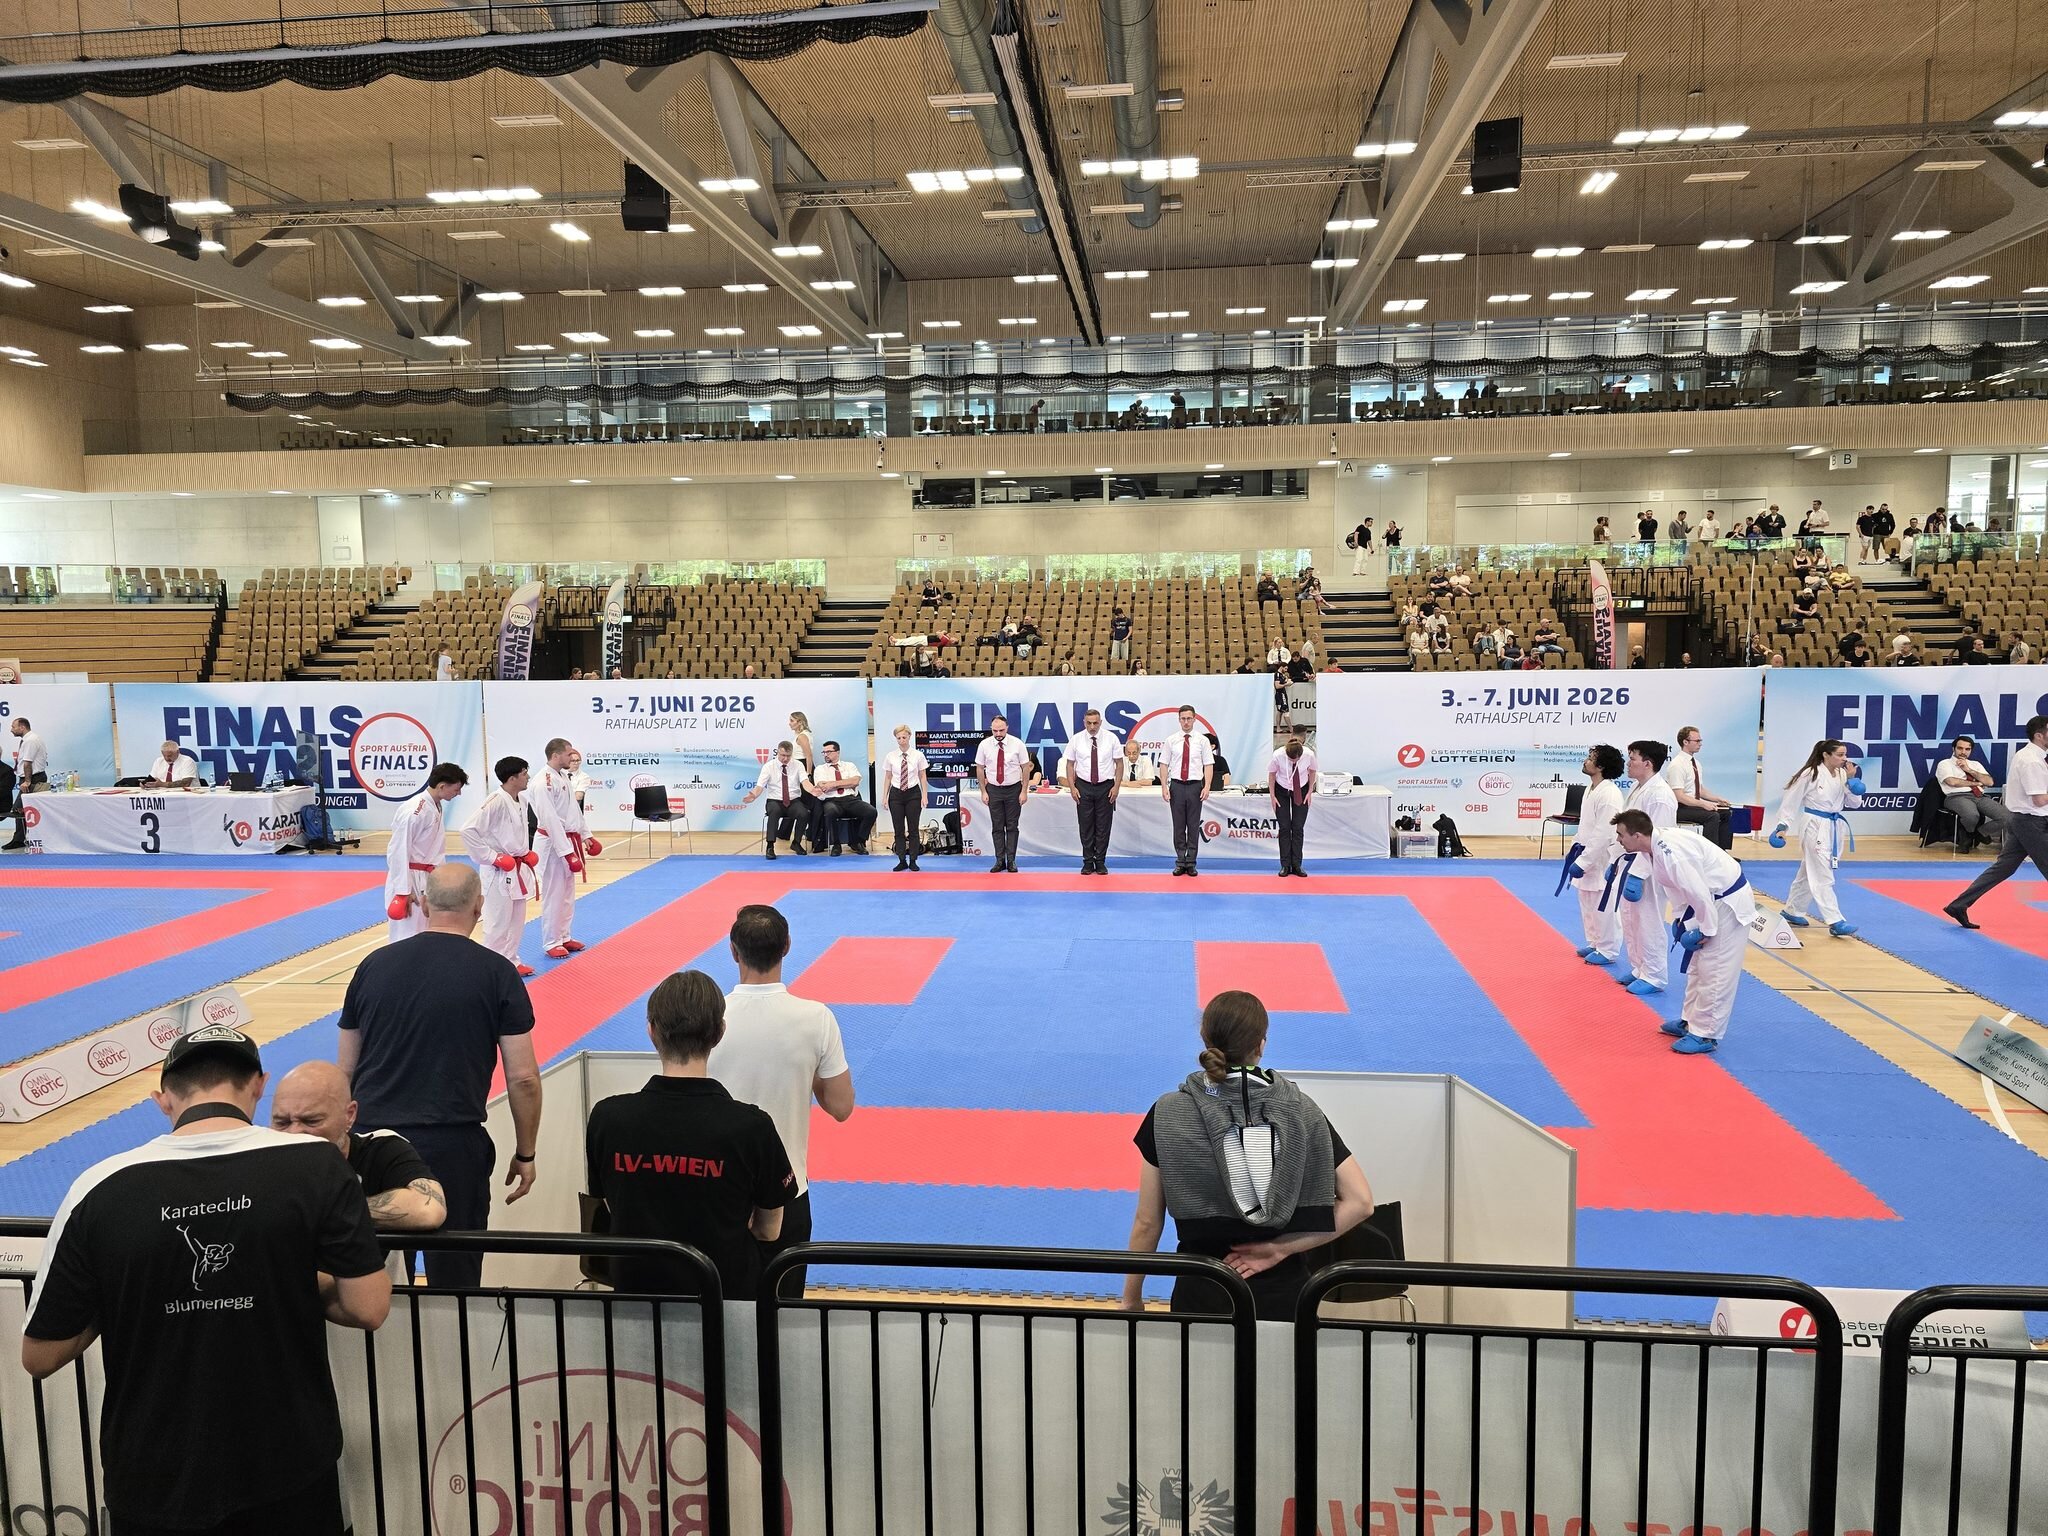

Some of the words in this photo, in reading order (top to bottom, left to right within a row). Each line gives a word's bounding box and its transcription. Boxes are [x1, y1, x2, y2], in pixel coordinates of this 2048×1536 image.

[1843, 454, 1852, 464] B
[1344, 462, 1353, 473] A
[907, 475, 914, 485] L
[434, 490, 442, 500] K
[511, 613, 531, 621] FINALS
[592, 696, 611, 713] 3.
[628, 696, 645, 713] 7.
[650, 695, 695, 716] JUNI
[701, 695, 756, 713] 2026
[1441, 689, 1462, 707] 3.
[1484, 689, 1501, 707] 7.
[1508, 688, 1559, 710] JUNI
[1567, 687, 1630, 706] 2026
[605, 717, 698, 730] RATHAUSPLATZ
[714, 717, 745, 730] WIEN
[1455, 711, 1562, 725] RATHAUSPLATZ
[1581, 711, 1617, 724] WIEN
[1825, 693, 2048, 741] FINAL
[163, 705, 363, 748] FINALS
[390, 743, 428, 752] AUSTRIA
[1138, 742, 1164, 750] SPOR
[361, 755, 429, 771] FINALS
[587, 758, 660, 766] LOTTERIEN
[1431, 755, 1516, 763] LOTTERIEN
[172, 748, 366, 789] FINAL
[129, 797, 166, 811] TATAMI
[619, 803, 633, 811] ÖB
[936, 795, 955, 806] DIE
[1465, 803, 1488, 812] ÖBB
[1519, 808, 1541, 817] Zeitung
[258, 811, 301, 831] KARAT
[1227, 817, 1278, 830] KARAT
[140, 812, 161, 854] 3
[210, 1005, 236, 1022] BiOTiC
[157, 1026, 184, 1044] BiOTiC
[92, 1045, 116, 1061] OMNi
[97, 1049, 127, 1069] BiOTiC
[1985, 1045, 2009, 1064] Wohnen,
[2010, 1060, 2030, 1077] Kunst,
[25, 1073, 51, 1089] OMNi
[1977, 1055, 2002, 1073] Medien
[1999, 1068, 2012, 1081] und
[2011, 1075, 2030, 1091] Sport
[31, 1077, 64, 1099] BiOTiC
[614, 1152, 725, 1178] LV-WIEN
[161, 1194, 252, 1222] Karateclub
[164, 1295, 255, 1314] Blumenegg
